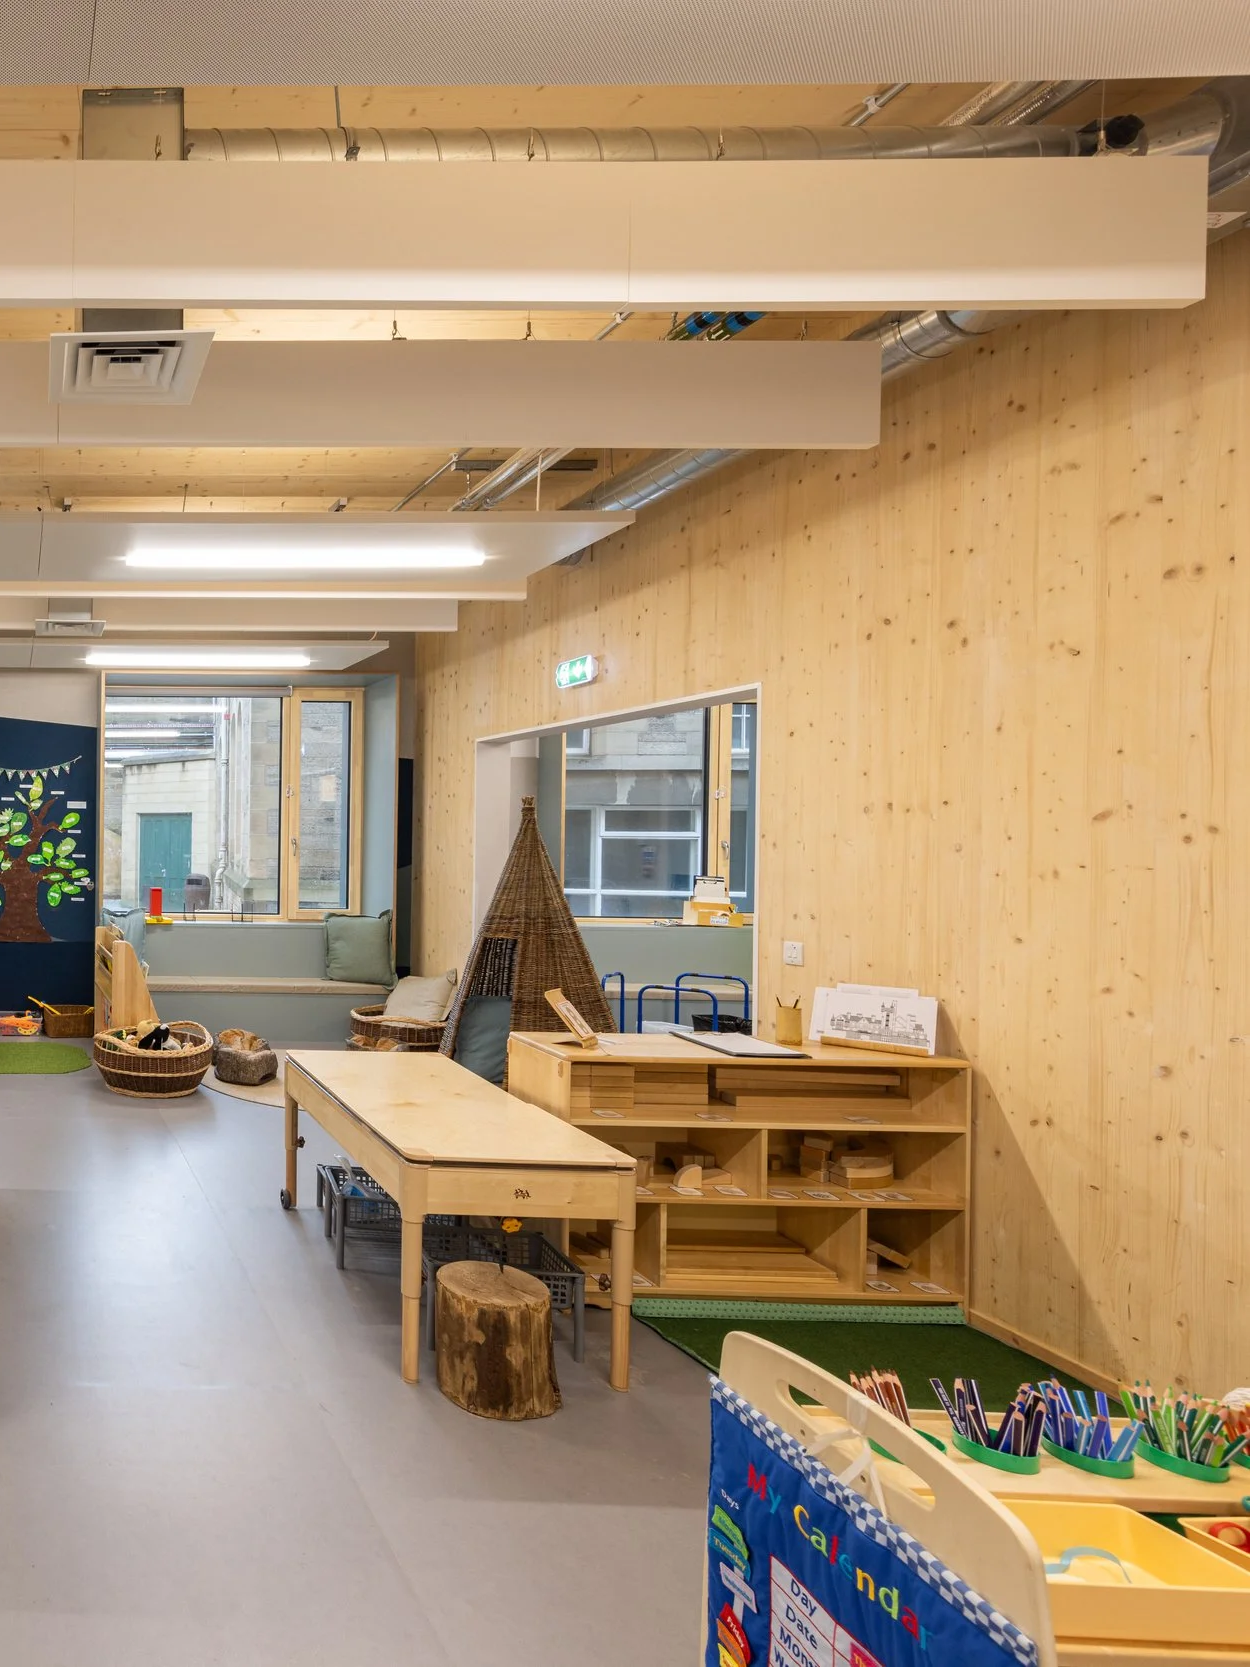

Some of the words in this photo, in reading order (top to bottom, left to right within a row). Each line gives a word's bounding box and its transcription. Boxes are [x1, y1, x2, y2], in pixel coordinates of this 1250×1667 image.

[720, 1488, 740, 1510] Days
[713, 1536, 746, 1571] Tuesday
[747, 1462, 782, 1514] My
[793, 1504, 933, 1650] Calendar
[790, 1578, 817, 1617] Day
[727, 1616, 745, 1648] Friday
[779, 1626, 818, 1667] Mon
[785, 1604, 818, 1650] Date
